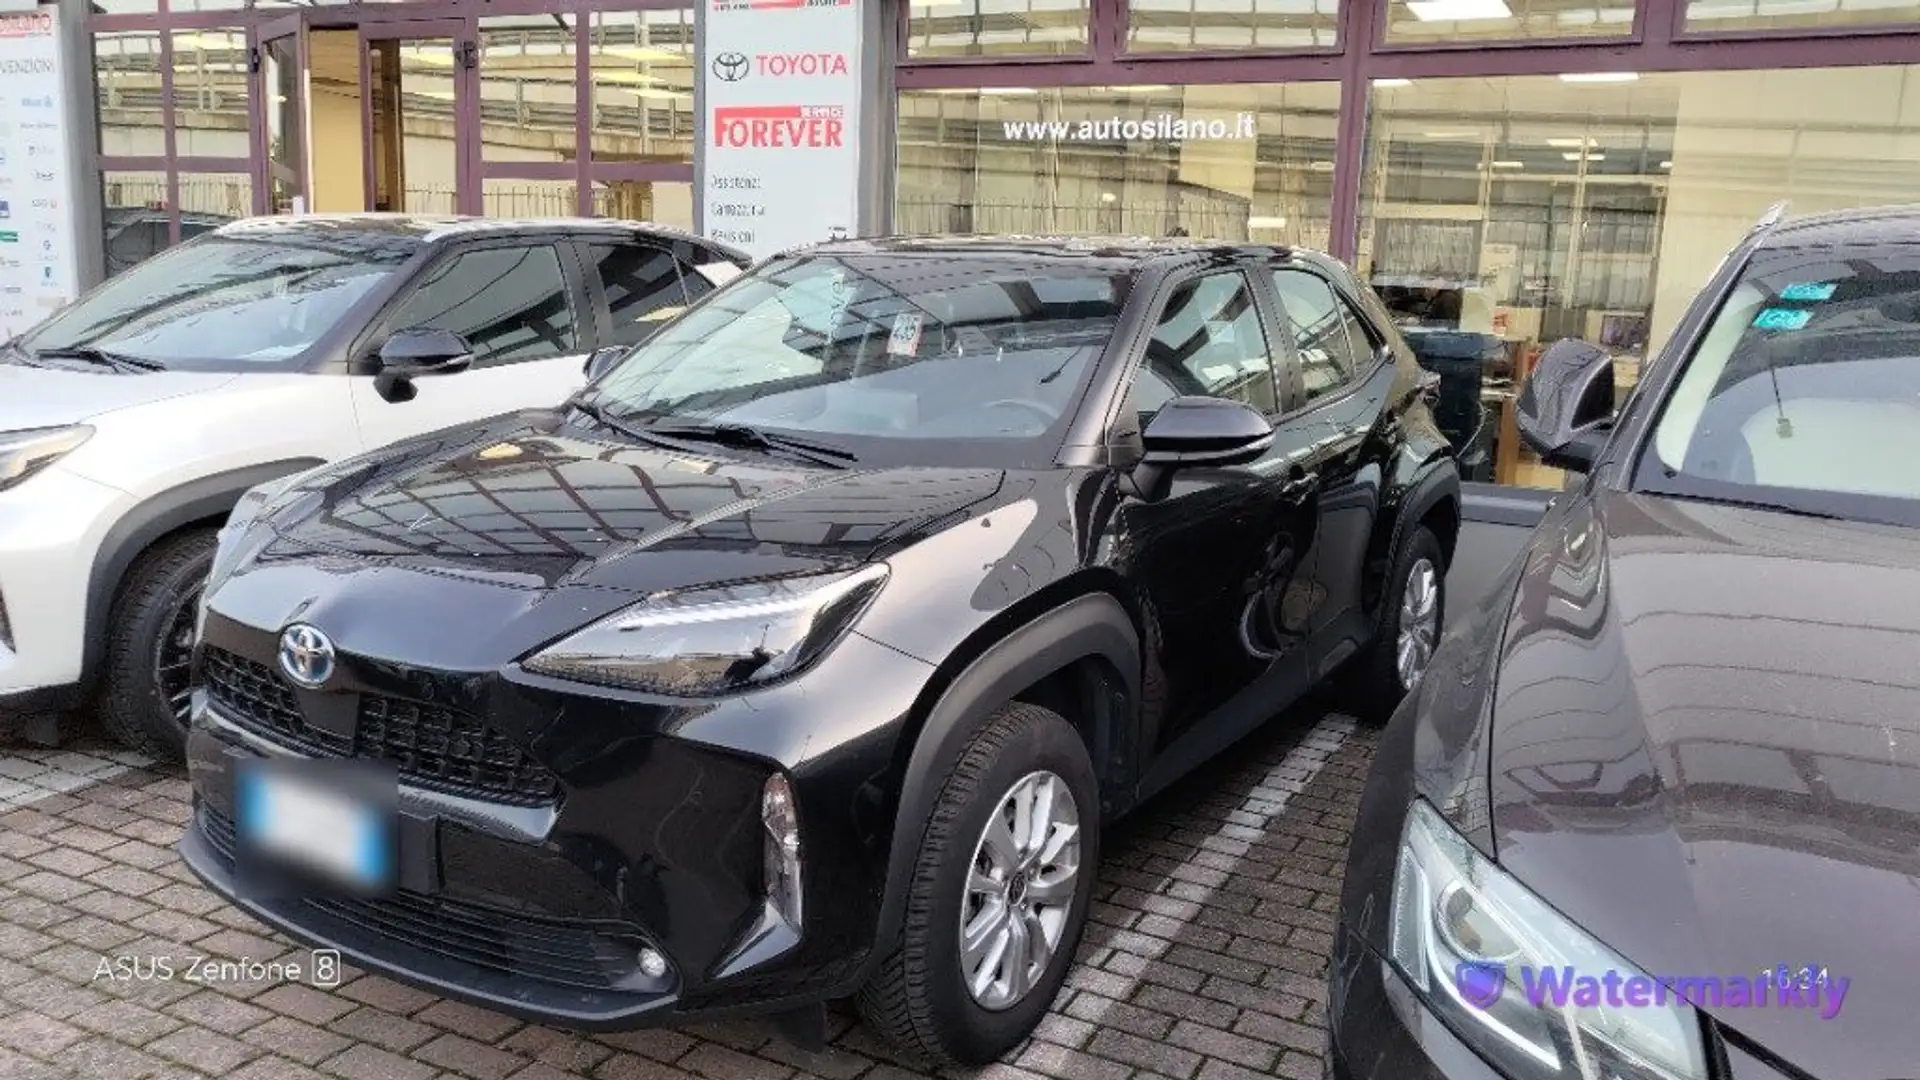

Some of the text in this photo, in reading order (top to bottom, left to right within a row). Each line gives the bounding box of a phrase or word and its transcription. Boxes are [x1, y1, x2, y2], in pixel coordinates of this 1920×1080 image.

[755, 54, 847, 77] TOYOTA
[714, 106, 842, 148] FOREVER
[1003, 111, 1256, 141] www.autosilano.it
